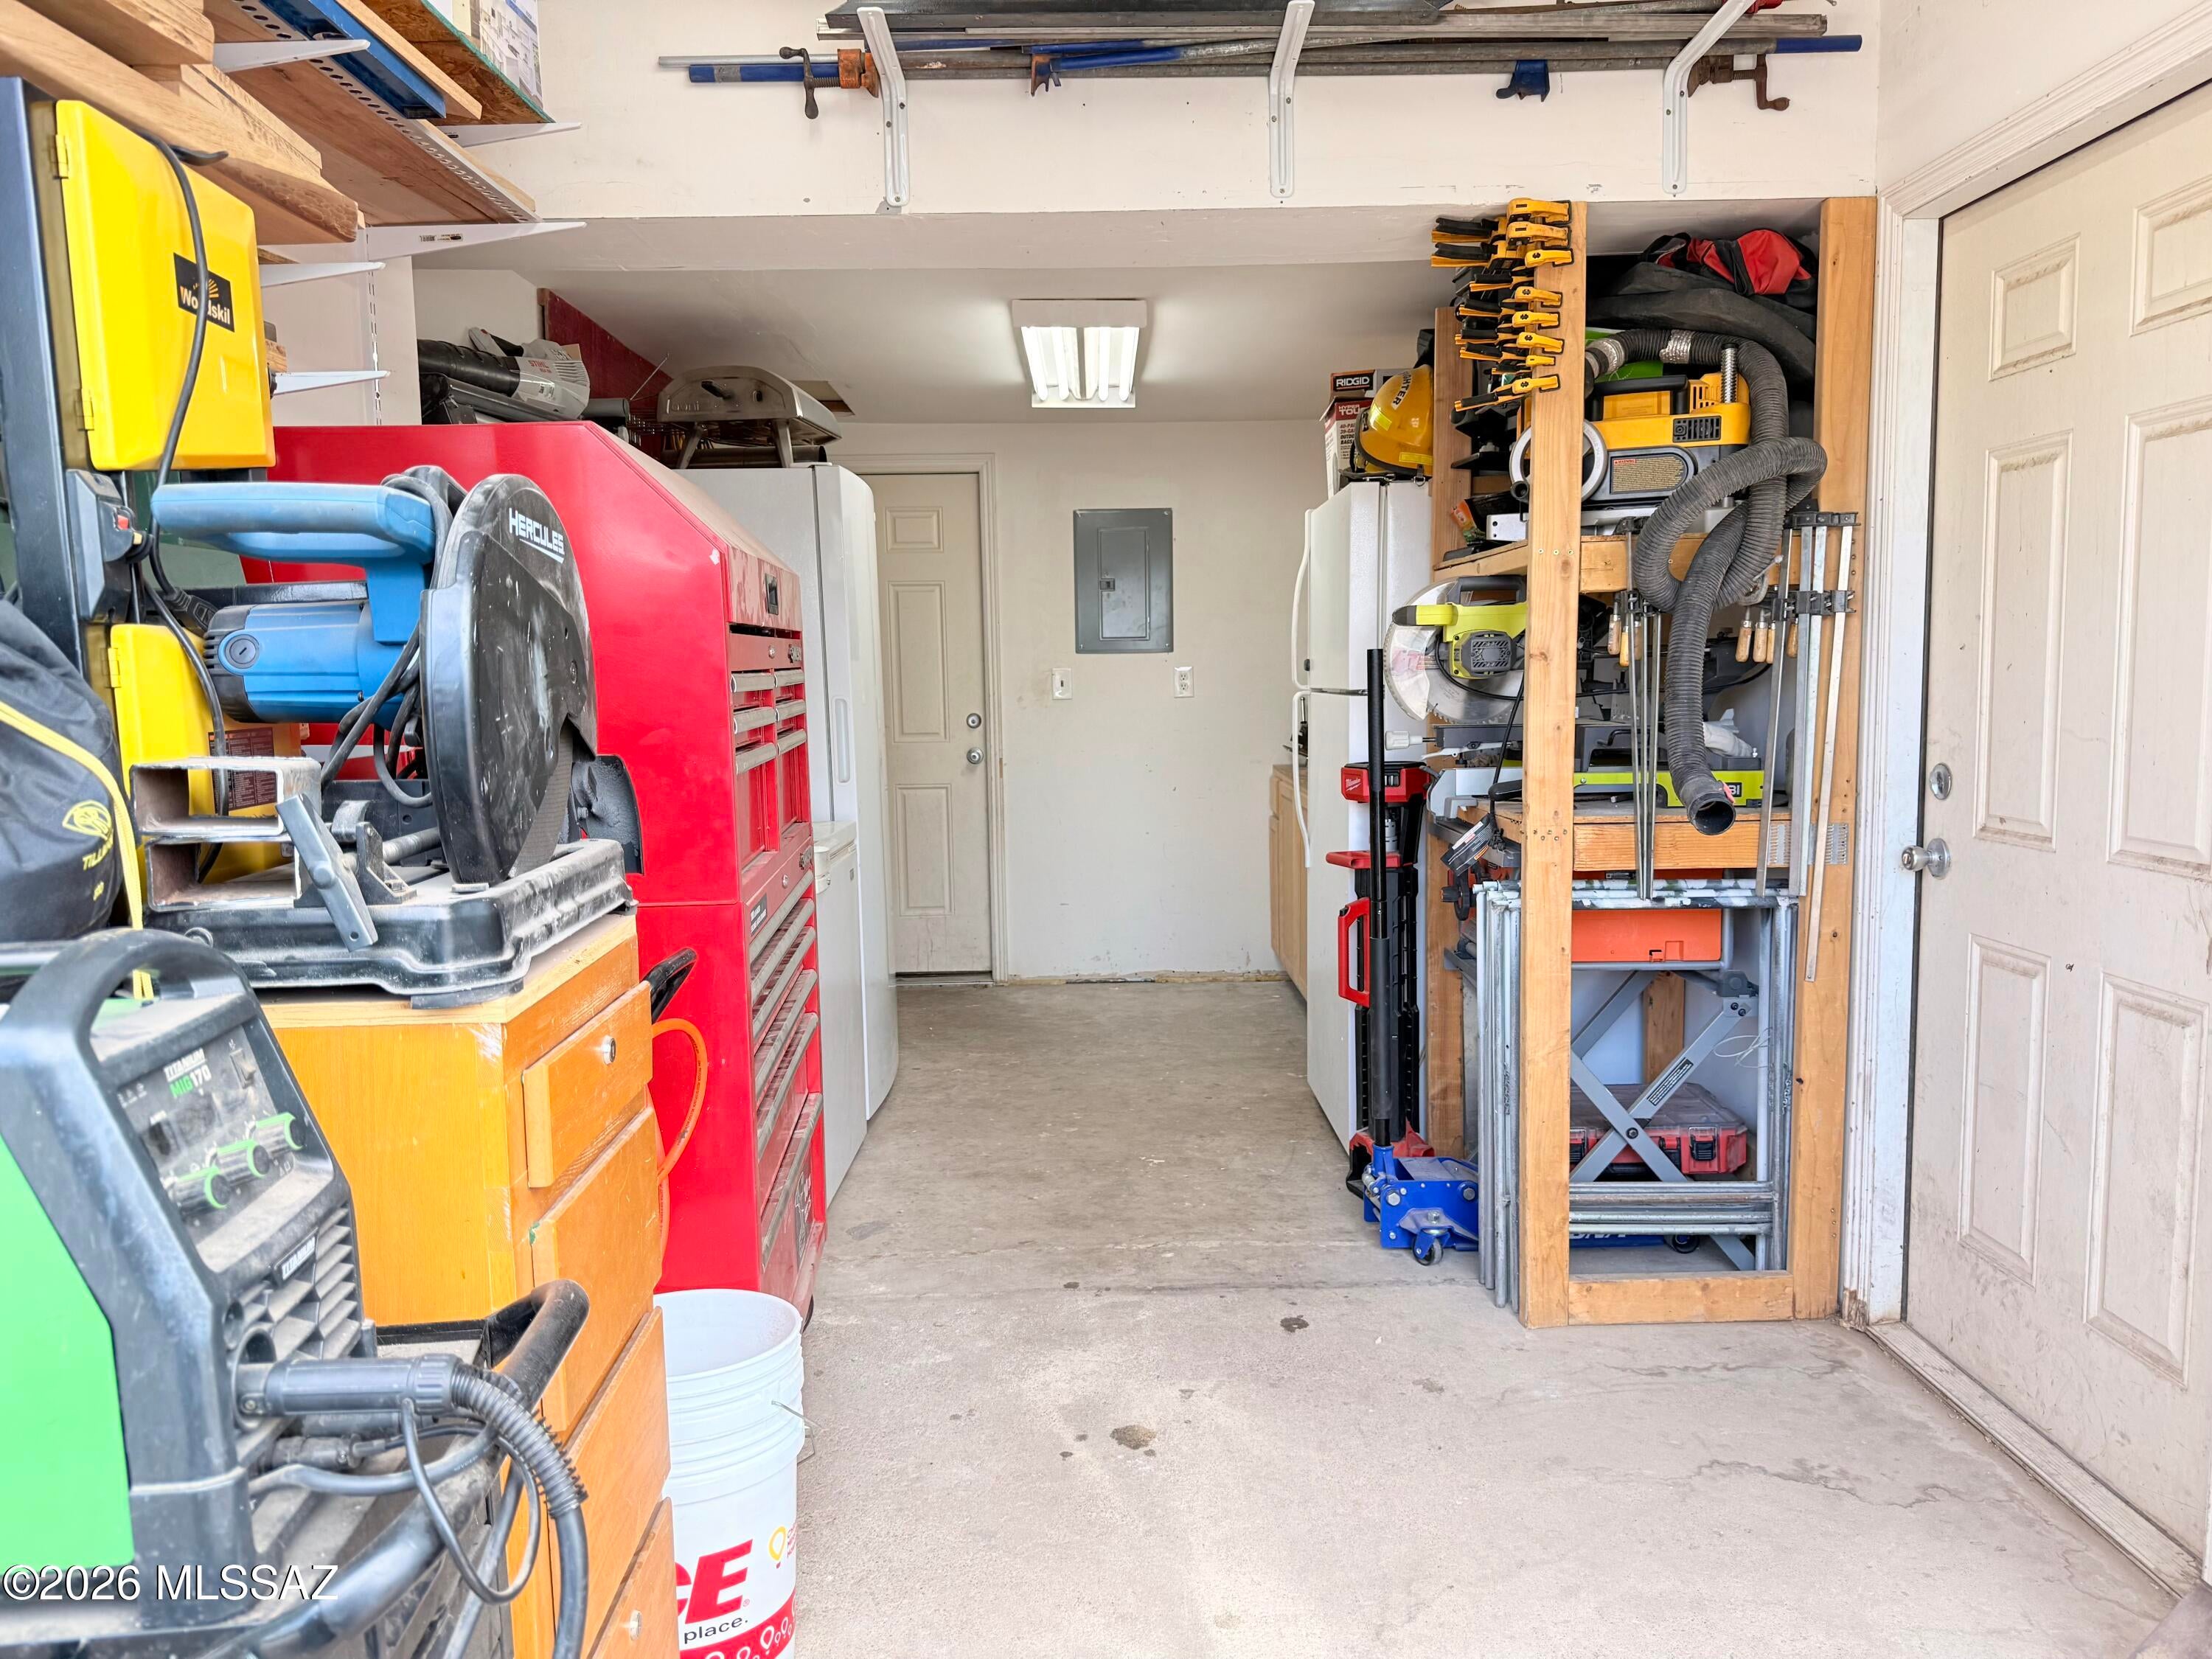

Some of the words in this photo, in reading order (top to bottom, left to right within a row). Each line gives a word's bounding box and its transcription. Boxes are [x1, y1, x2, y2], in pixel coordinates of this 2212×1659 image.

[180, 285, 231, 324] Wodskil
[1336, 377, 1370, 387] RIDGID
[509, 507, 565, 555] HERCULES
[164, 1048, 206, 1080] TITANIUM
[684, 1617, 748, 1644] place.
